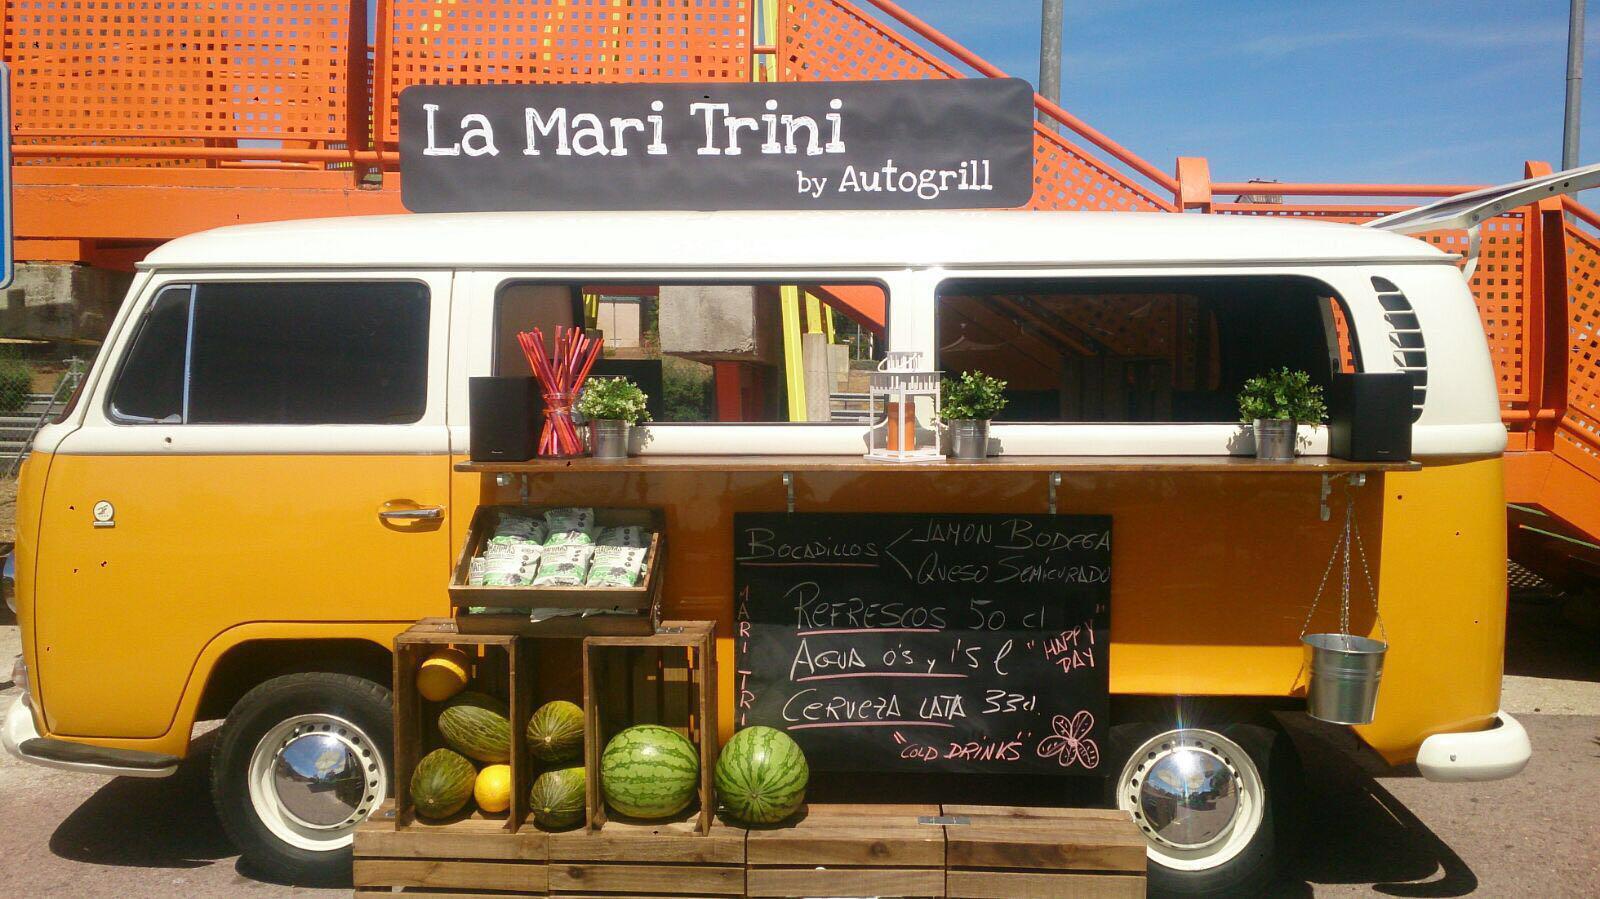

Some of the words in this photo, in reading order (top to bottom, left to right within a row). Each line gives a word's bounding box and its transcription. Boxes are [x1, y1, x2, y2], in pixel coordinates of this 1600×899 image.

[422, 103, 498, 157] La
[523, 100, 668, 156] Mari
[690, 98, 847, 156] Trini
[797, 171, 826, 198] by
[838, 160, 994, 199] Autogrill
[912, 518, 993, 546] JAMON
[968, 599, 1006, 631] 50
[790, 638, 867, 682] AGUA
